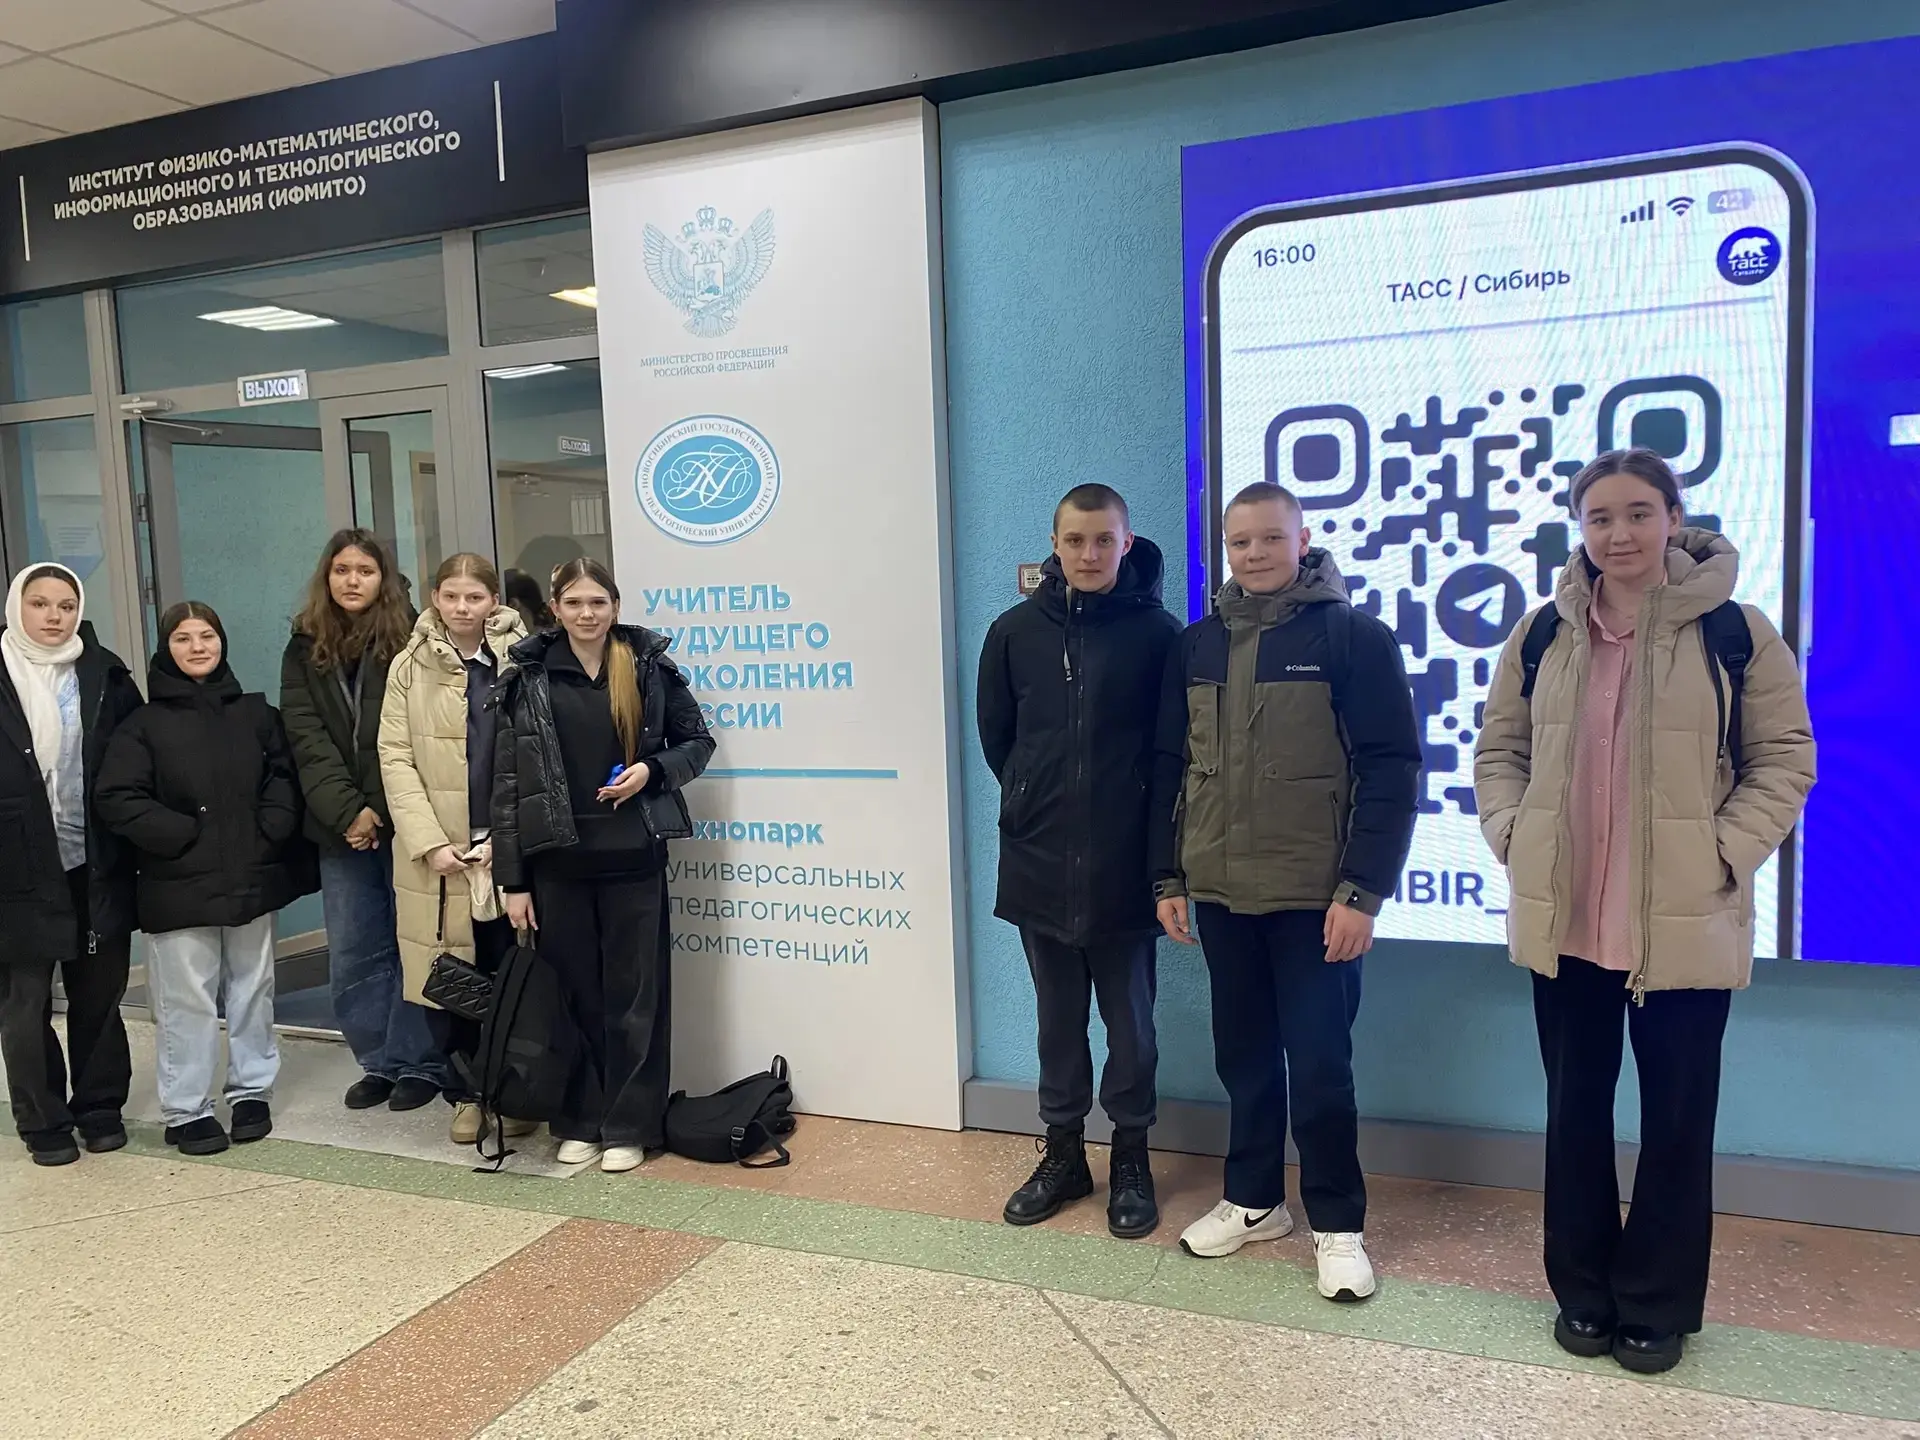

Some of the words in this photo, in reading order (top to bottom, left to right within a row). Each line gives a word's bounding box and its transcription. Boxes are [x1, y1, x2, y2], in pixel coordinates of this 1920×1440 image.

[68, 161, 155, 193] ИНСТИТУТ
[158, 109, 440, 177] ФИЗИКО-МАТЕМАТИЧЕСКОГО,
[54, 172, 234, 220] ИНФОРМАЦИОННОГО
[238, 169, 251, 188] И
[255, 130, 461, 185] ТЕХНОЛОГИЧЕСКОГО
[132, 191, 264, 231] ОБРАЗОВАНИЯ
[267, 175, 367, 211] (ИФМИТО)
[1253, 243, 1316, 268] 16:00
[1386, 278, 1452, 303] ТАСС
[1474, 269, 1571, 293] Сибирь
[640, 352, 714, 367] МИНИСТЕРСТВО
[716, 345, 789, 361] ПРОСВЕЩЕНИЯ
[653, 363, 715, 378] РОССИЙСКОЙ
[716, 359, 775, 373] ФЕДЕРАЦИИ
[245, 376, 300, 399] ВЫХОД
[642, 423, 697, 489] НОВОСИБИРСКИЙ
[700, 422, 776, 480] ГОСУДАРСТВЕННЫЙ
[646, 496, 718, 537] ПЕДАГОГИЧЕСКИЙ
[719, 487, 773, 536] УНИВЕРСИТЕТ
[642, 583, 793, 615] УЧИТЕЛЬ
[649, 621, 831, 657] УДУЩЕГО
[678, 660, 854, 692] КОЛЕНИЯ
[699, 701, 783, 730] ССИИ
[692, 819, 825, 850] хнопарк
[668, 860, 905, 891] универсальных
[669, 895, 912, 930] педагогических
[670, 931, 869, 966] компетенций
